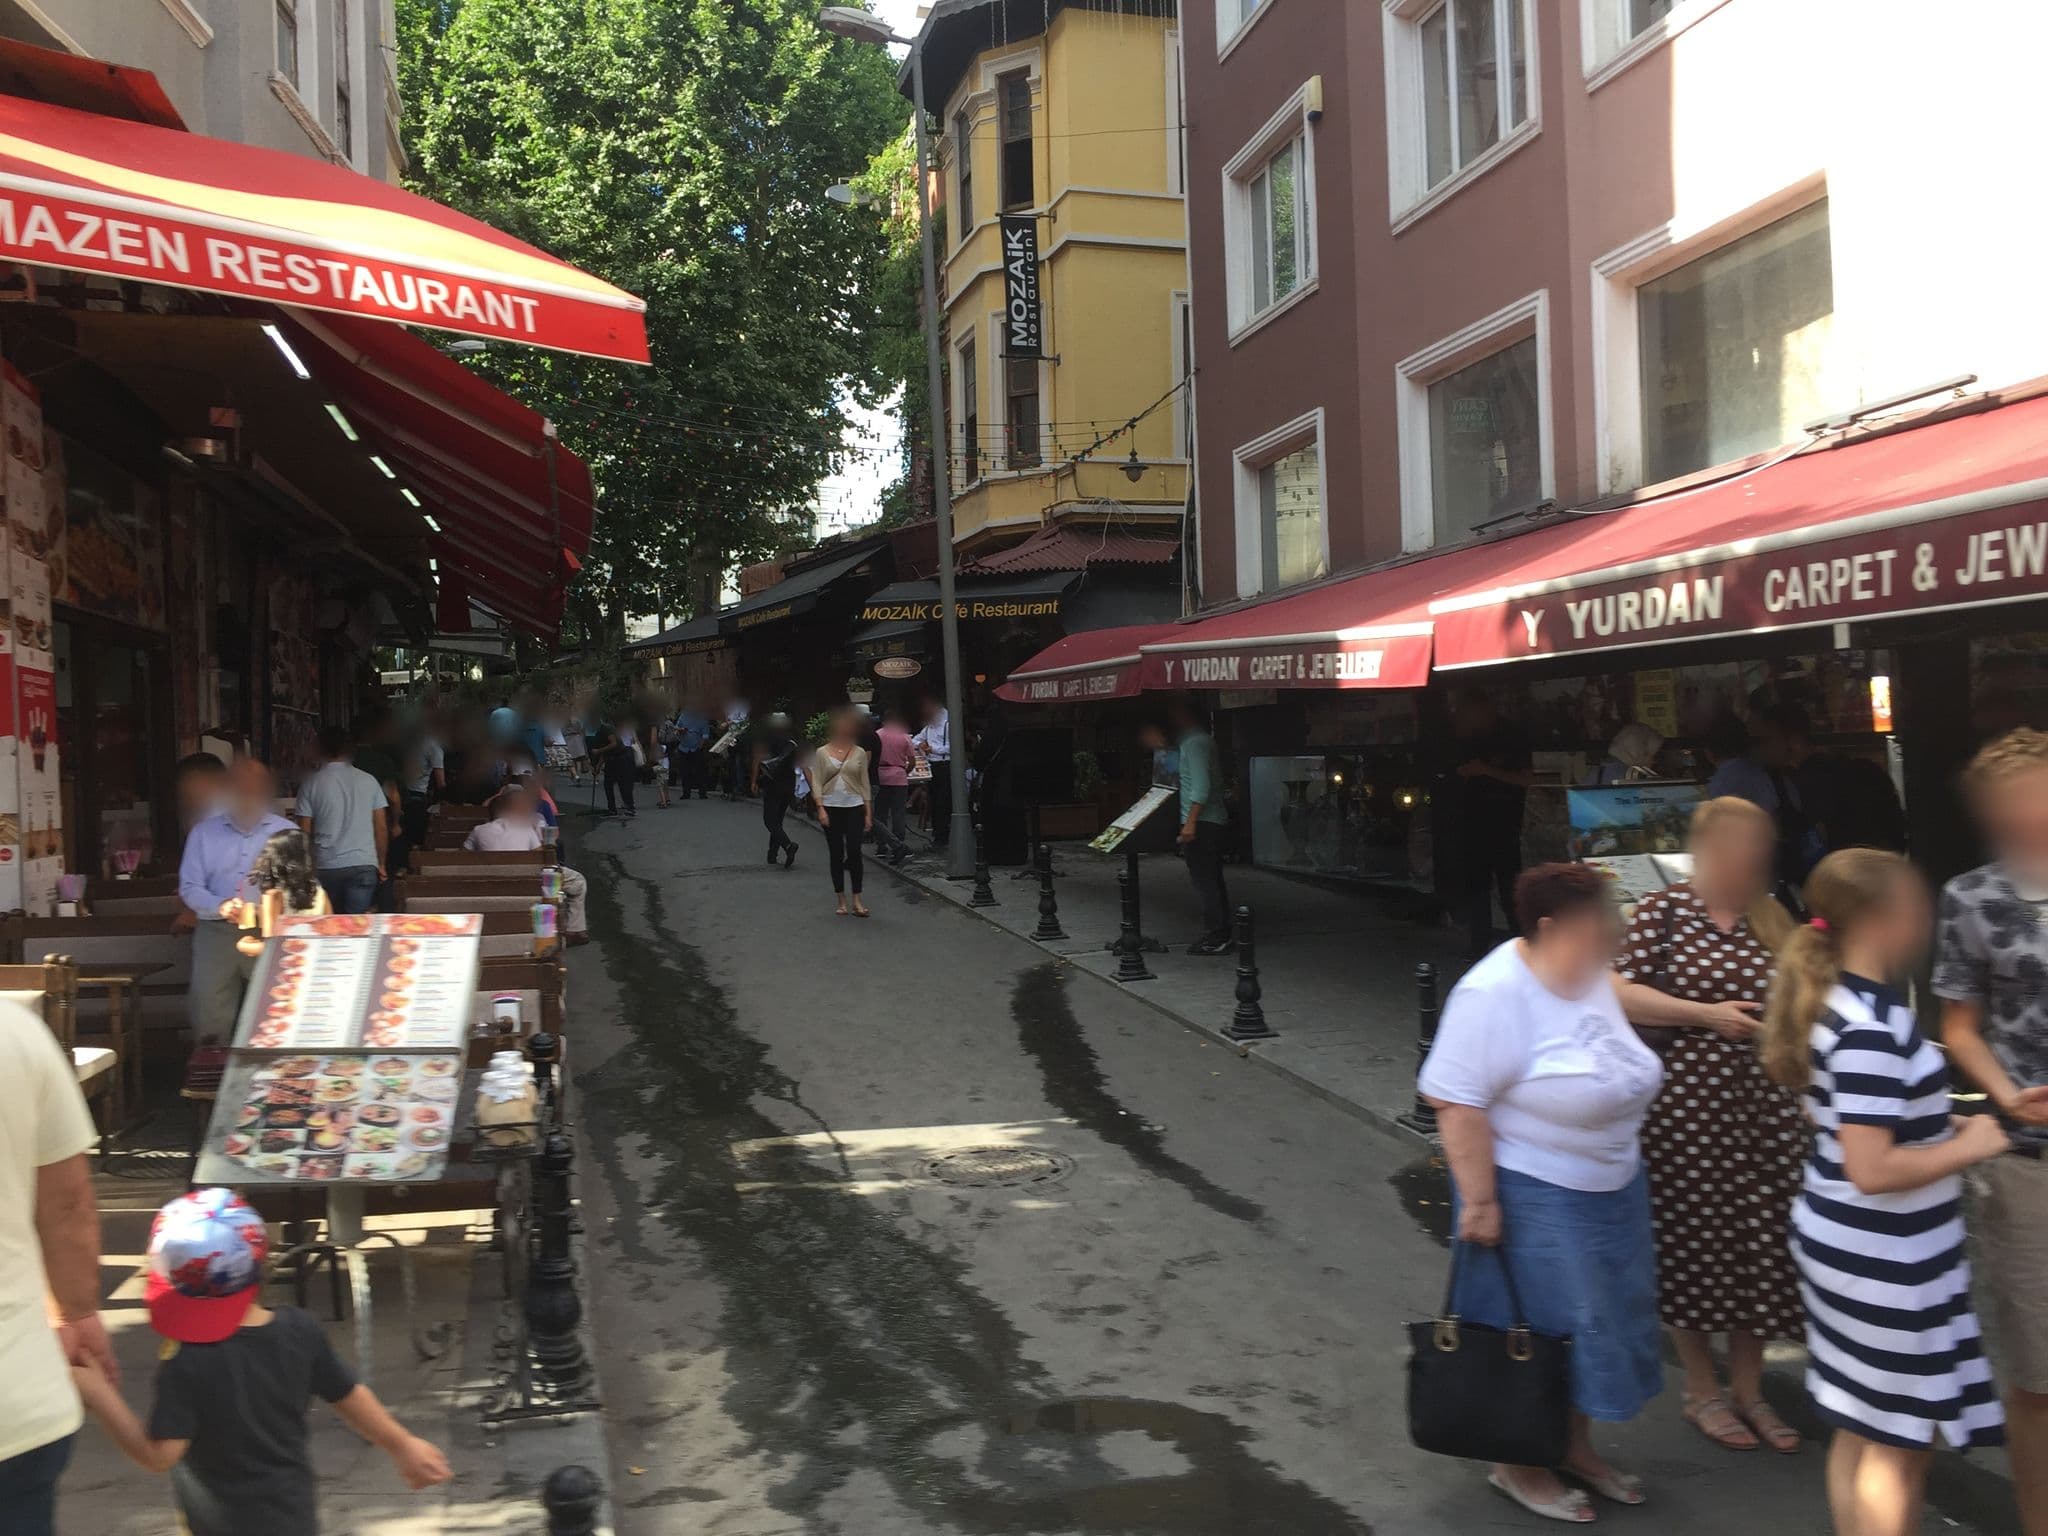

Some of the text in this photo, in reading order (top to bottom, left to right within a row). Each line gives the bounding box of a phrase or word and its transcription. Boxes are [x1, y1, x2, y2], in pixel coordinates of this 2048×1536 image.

[205, 237, 540, 333] RESTAURANT
[932, 603, 969, 620] Cfé
[973, 599, 1059, 618] Restaurant
[1521, 609, 1546, 648] Y
[1566, 575, 1725, 640] YURDAN
[1763, 549, 1898, 613] CARPET
[1912, 542, 1939, 592] &
[1164, 660, 1175, 684] Y
[1182, 656, 1241, 683] YURDAN
[1249, 654, 1293, 681] CARPET
[1296, 653, 1306, 680] &
